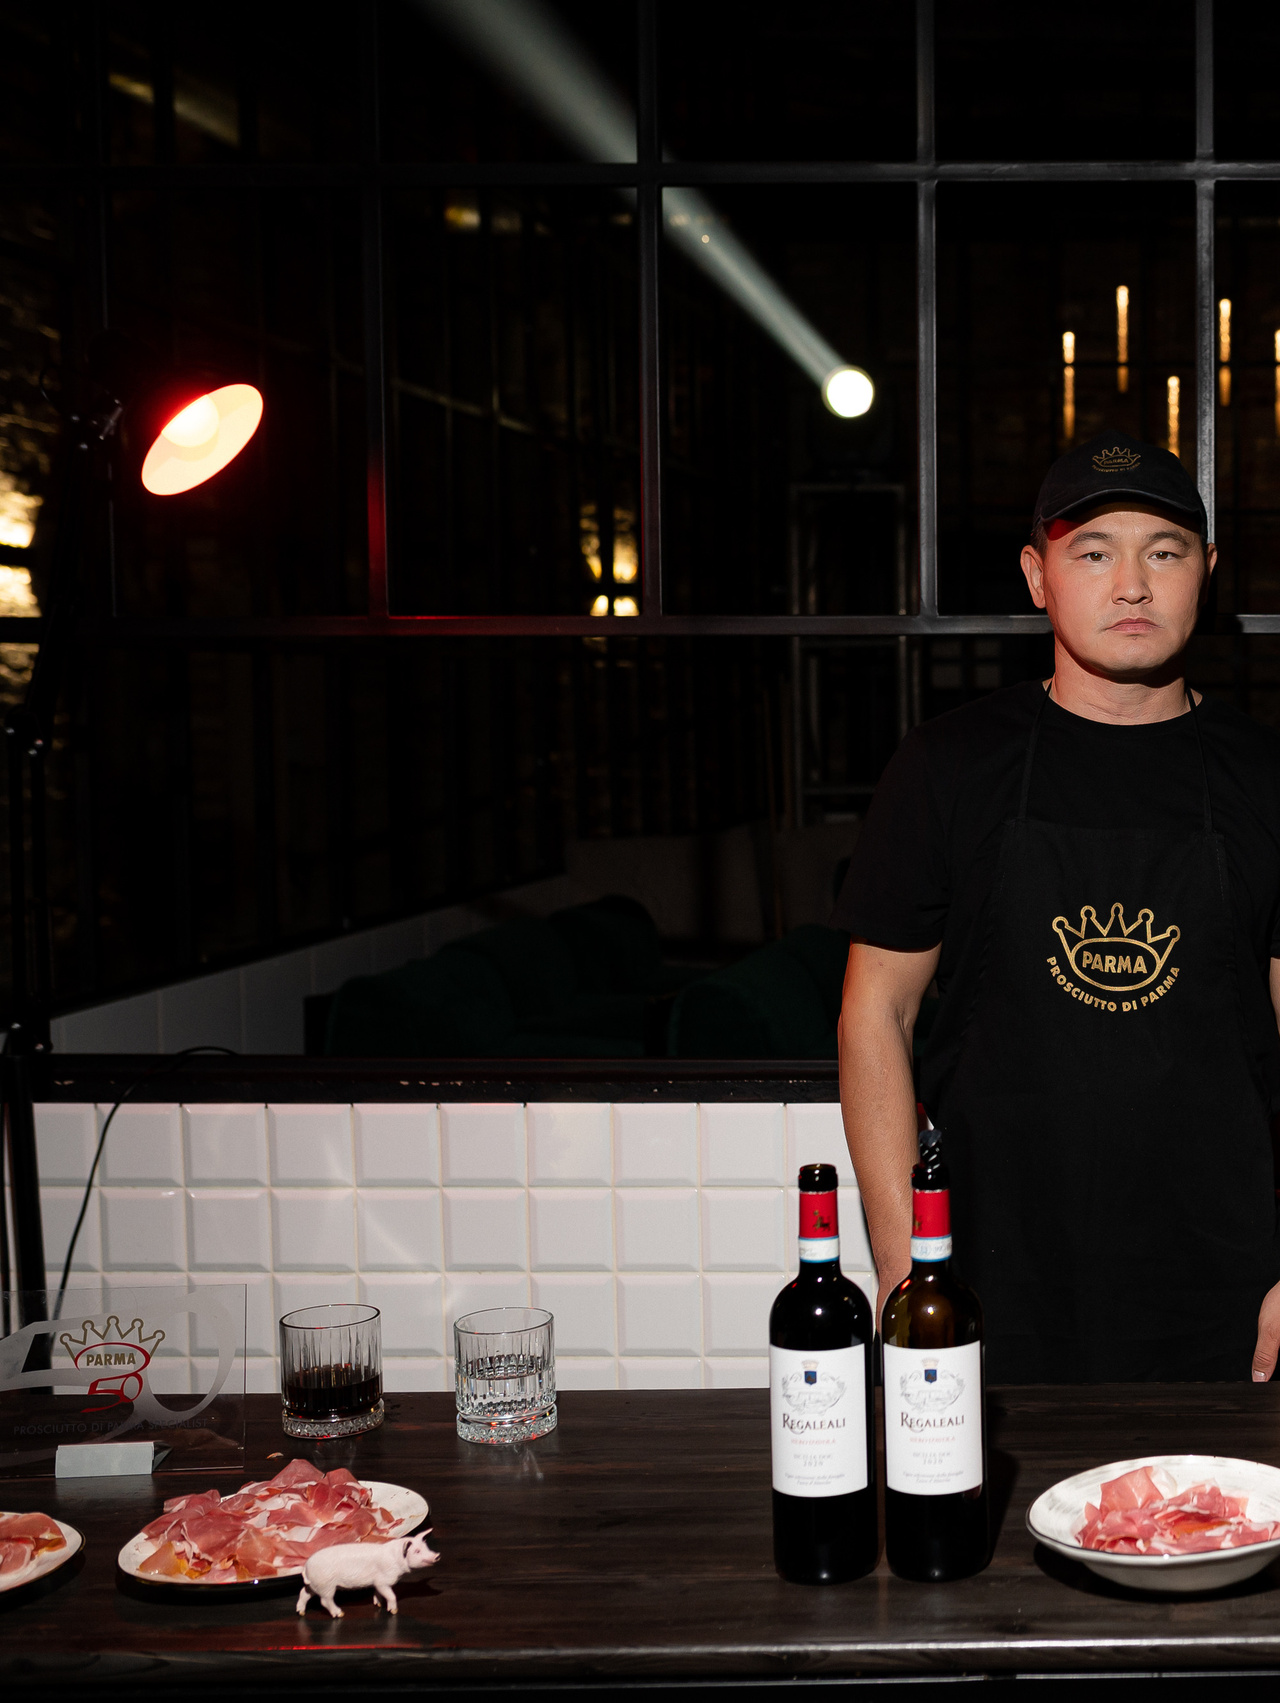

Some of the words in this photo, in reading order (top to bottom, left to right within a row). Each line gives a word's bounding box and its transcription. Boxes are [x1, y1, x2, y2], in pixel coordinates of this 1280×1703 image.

[1082, 951, 1148, 974] PARMA
[1046, 956, 1117, 1012] PROSCIUTTO
[1122, 1000, 1138, 1012] DI
[1140, 966, 1181, 1007] PARMA
[86, 1352, 136, 1367] PARMA
[13, 1421, 87, 1436] PROSCIUTTO
[92, 1421, 104, 1432] DI
[150, 1417, 208, 1431] SPECIALIST
